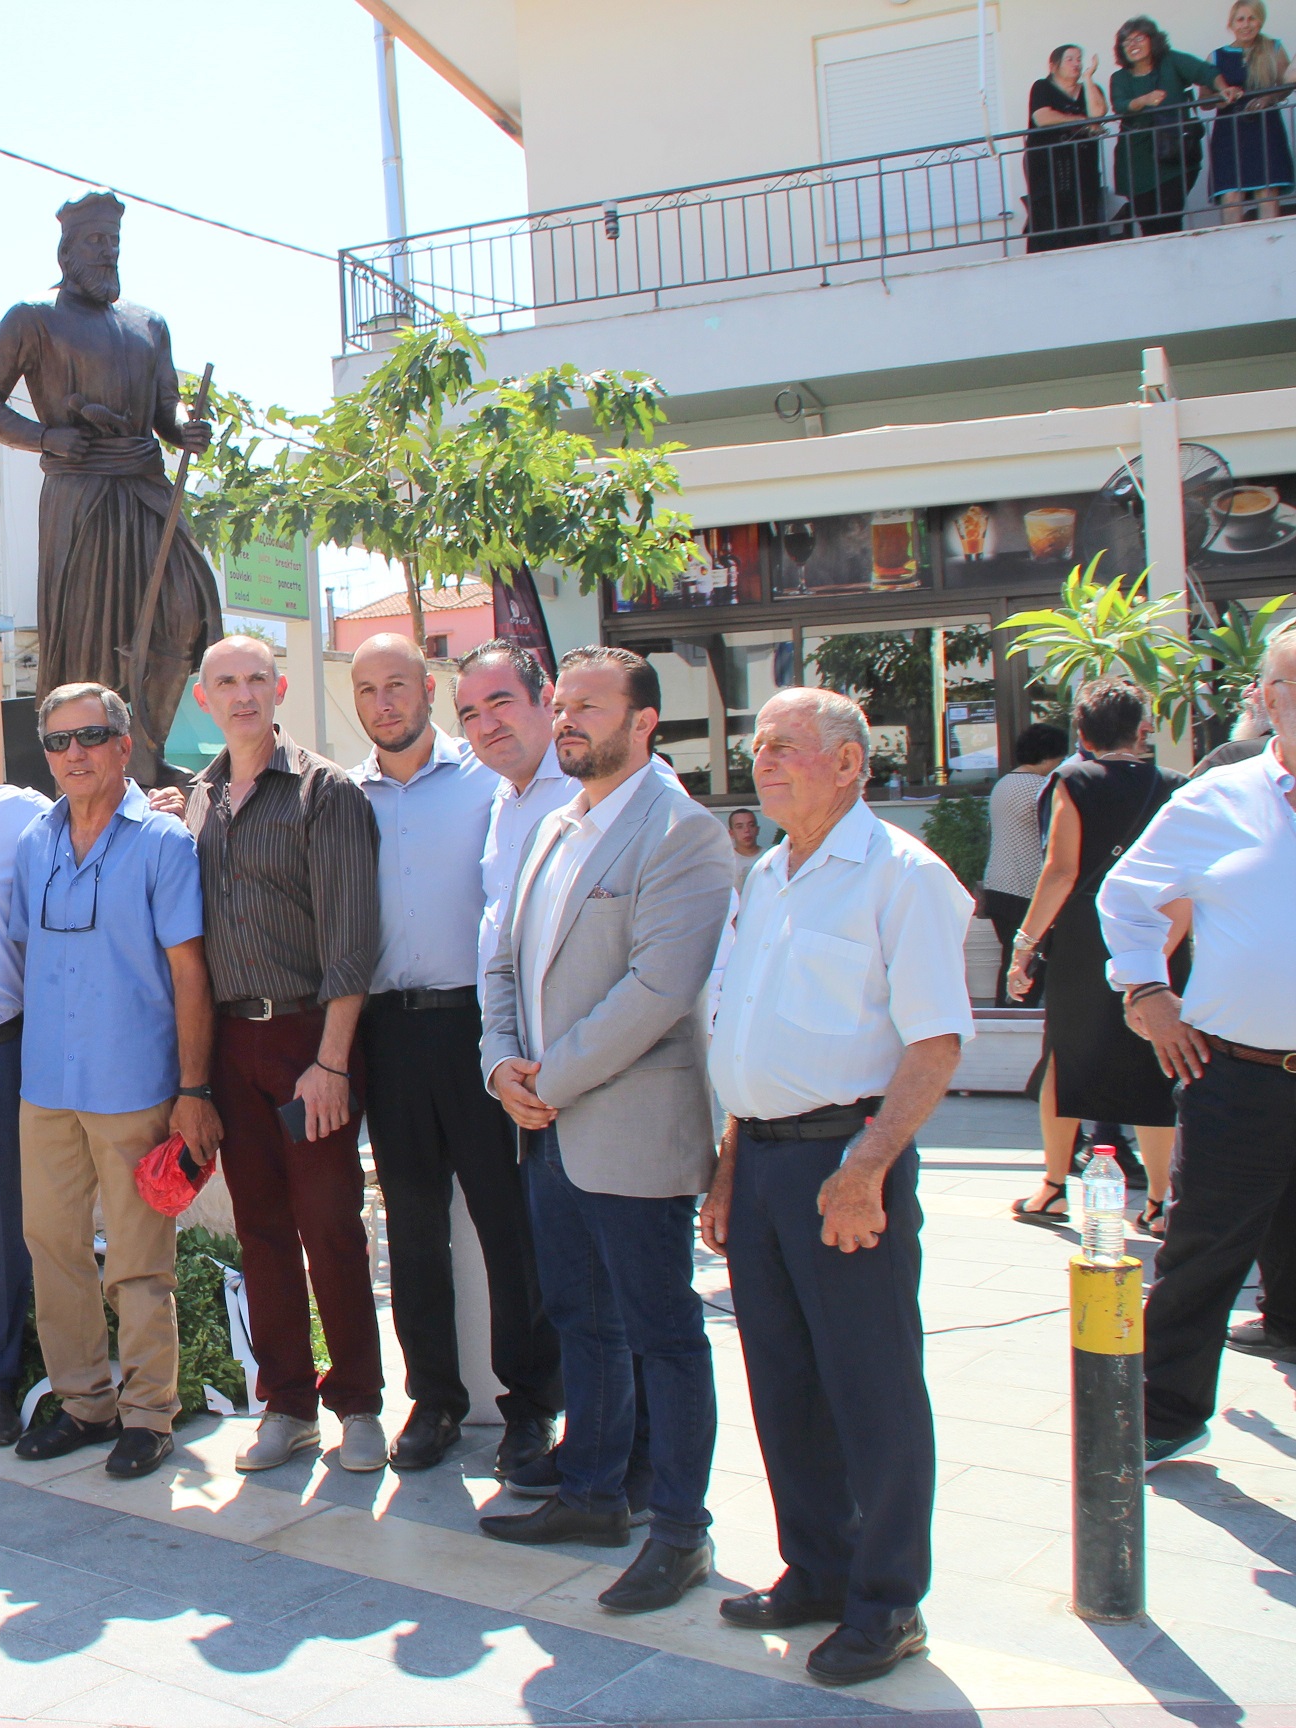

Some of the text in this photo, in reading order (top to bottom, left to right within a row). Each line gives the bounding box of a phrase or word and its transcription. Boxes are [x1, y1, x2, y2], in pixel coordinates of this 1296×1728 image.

[275, 556, 302, 571] breakfast
[229, 570, 252, 583] souvlaki
[277, 579, 302, 592] pancetta
[234, 590, 250, 602] salad
[285, 599, 297, 610] wine
